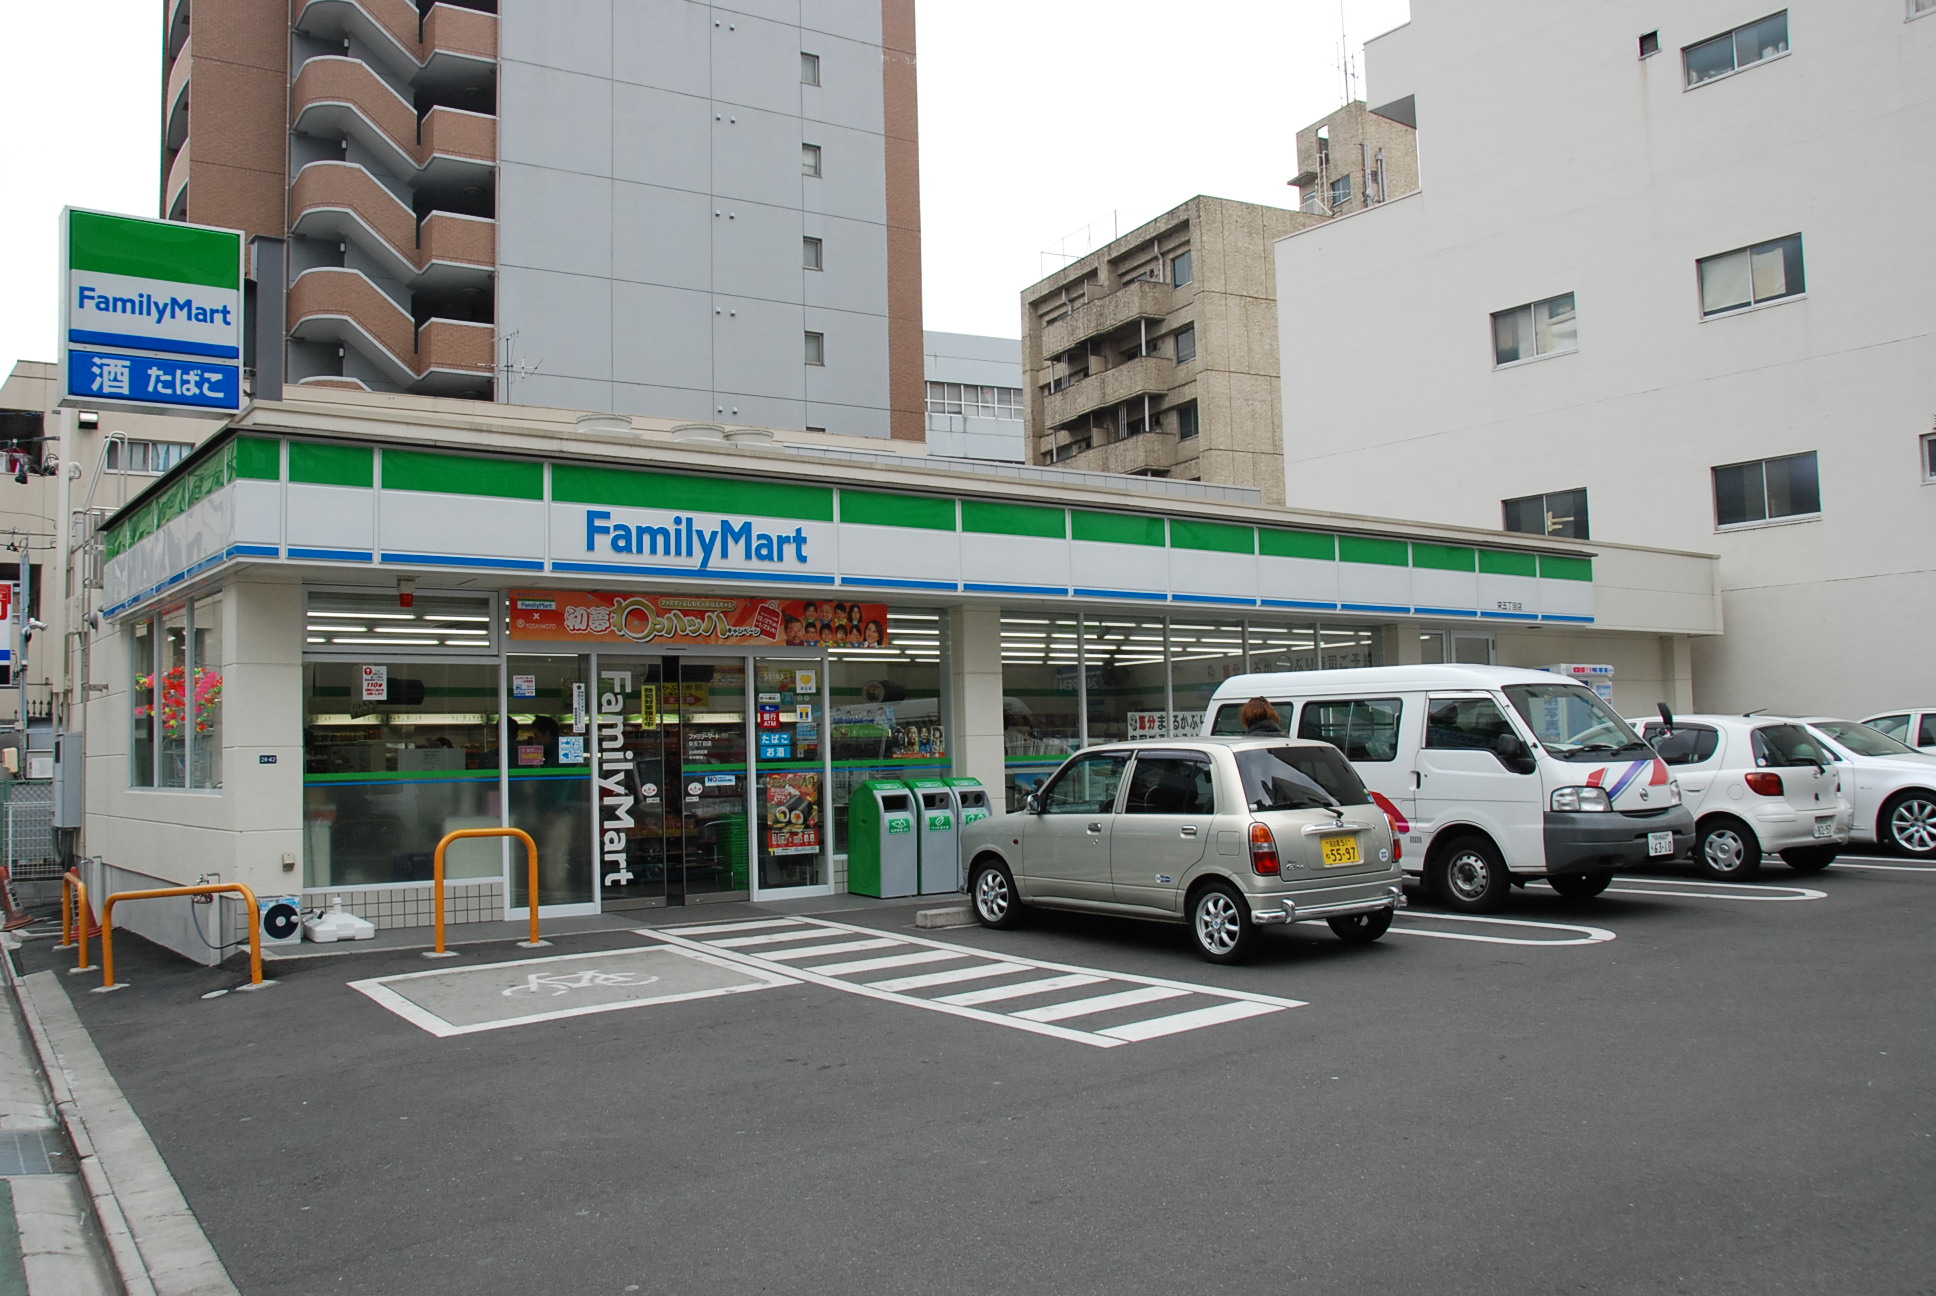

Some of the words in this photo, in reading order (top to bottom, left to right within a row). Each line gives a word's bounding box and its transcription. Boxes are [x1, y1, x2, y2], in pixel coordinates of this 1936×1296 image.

[78, 285, 231, 325] FamilyMart
[91, 356, 131, 395] 酒
[147, 366, 225, 398] たばこ
[586, 509, 808, 570] FamilyMart
[520, 602, 553, 610] FamilyMart
[525, 622, 556, 630] YOSHIMOTO
[763, 712, 777, 721] 銀行
[688, 732, 720, 740] ファミリーマート
[761, 734, 789, 744] たばこ
[766, 747, 785, 757] お酒
[600, 671, 635, 887] FamilyMart
[1654, 840, 1672, 854] 63-10
[1331, 847, 1355, 862] 55-97
